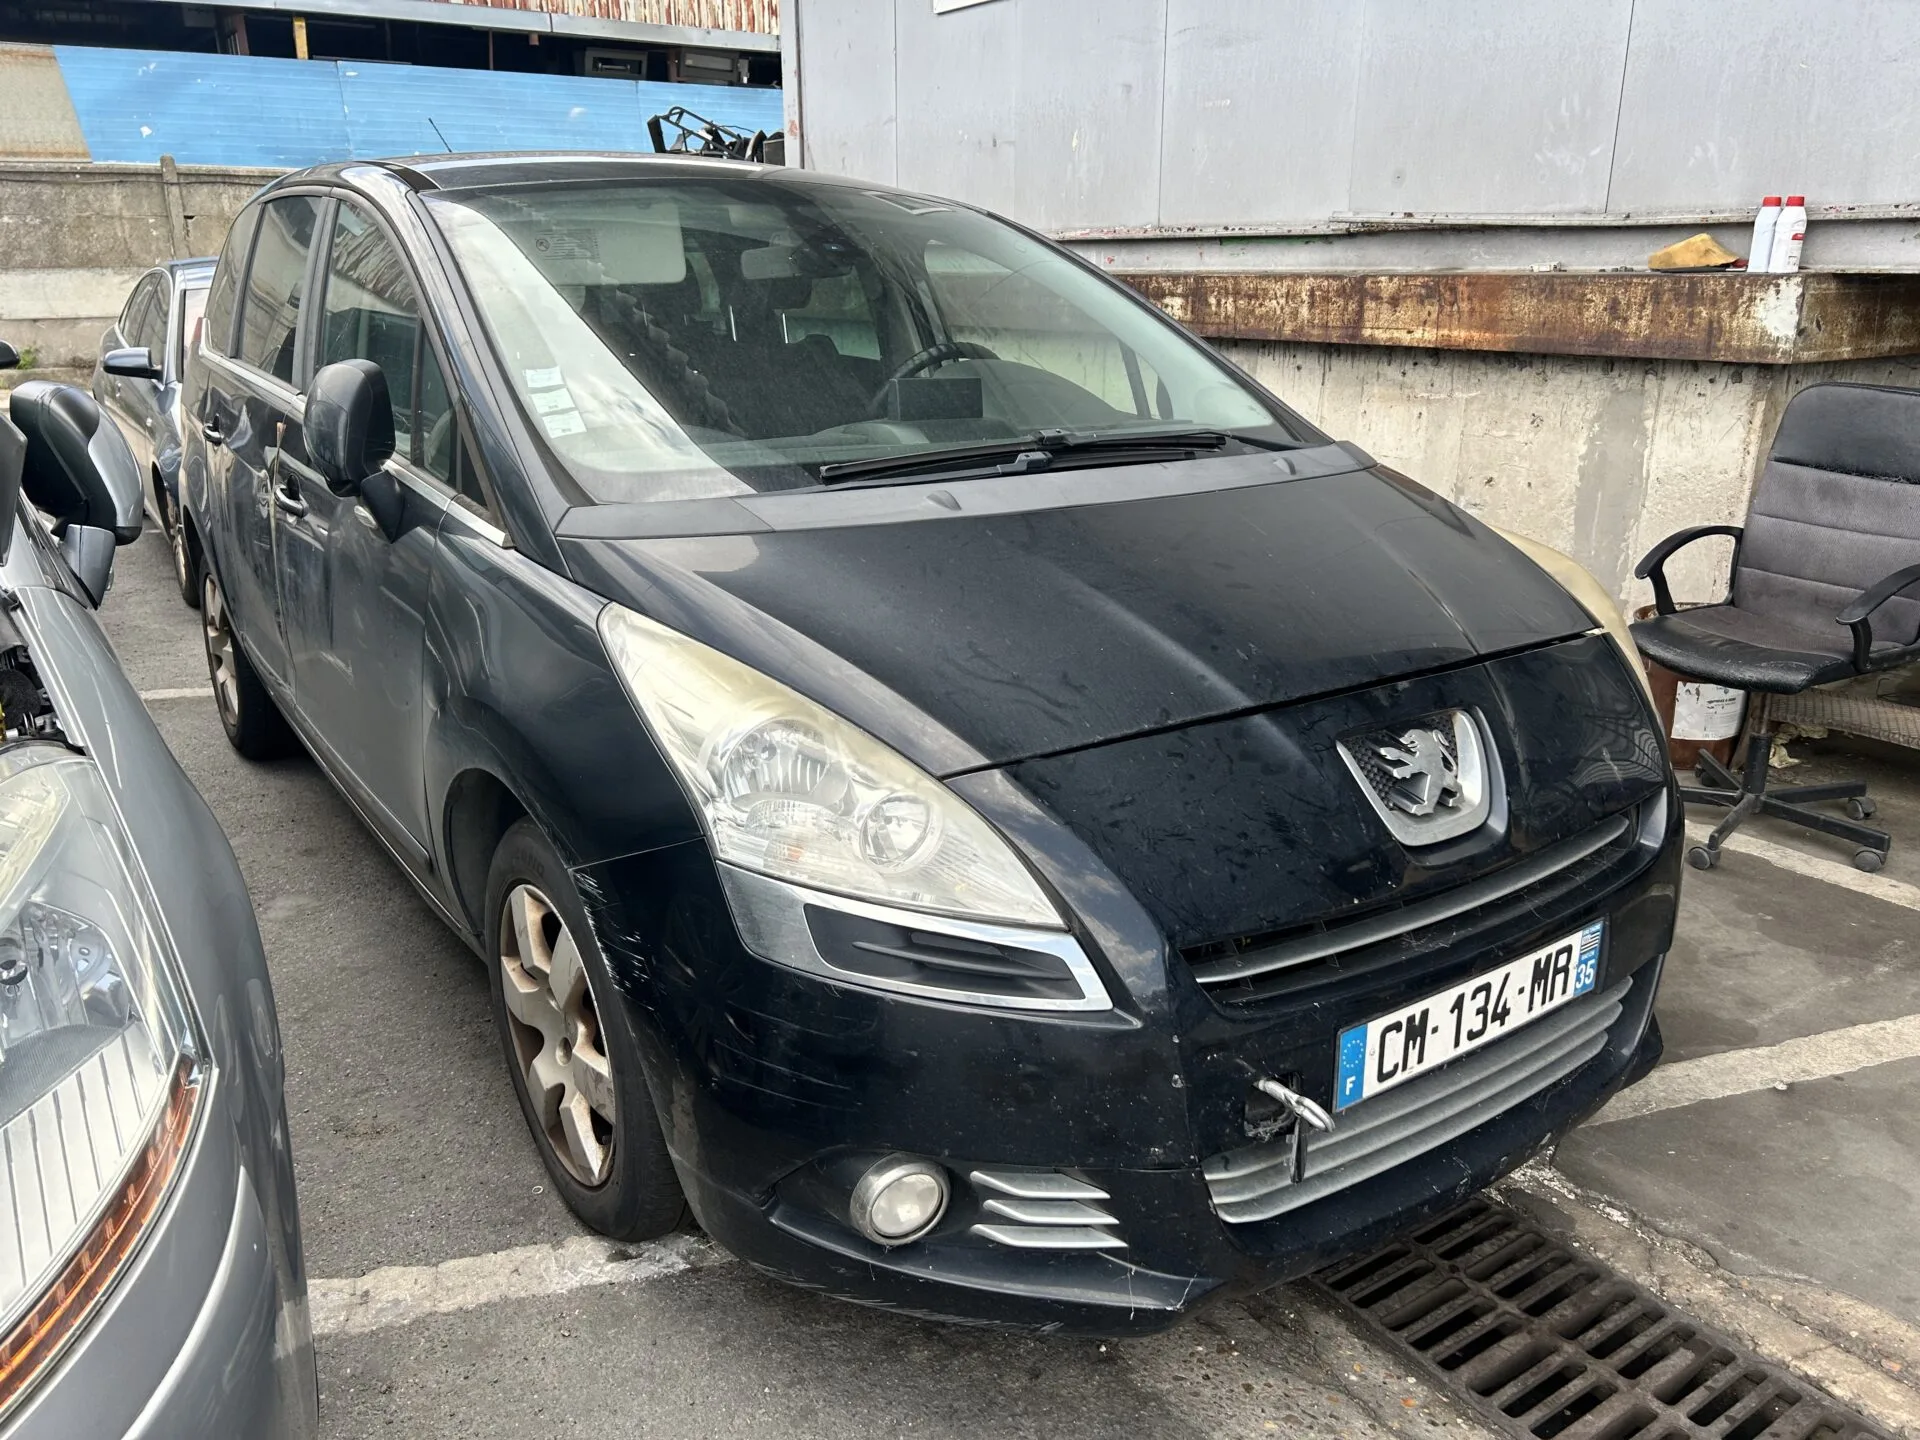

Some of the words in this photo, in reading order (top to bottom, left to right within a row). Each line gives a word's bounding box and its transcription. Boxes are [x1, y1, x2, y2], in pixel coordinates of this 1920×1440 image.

[1575, 959, 1595, 989] 35
[1376, 944, 1573, 1083] CM-134-MR
[1345, 1076, 1356, 1096] F
